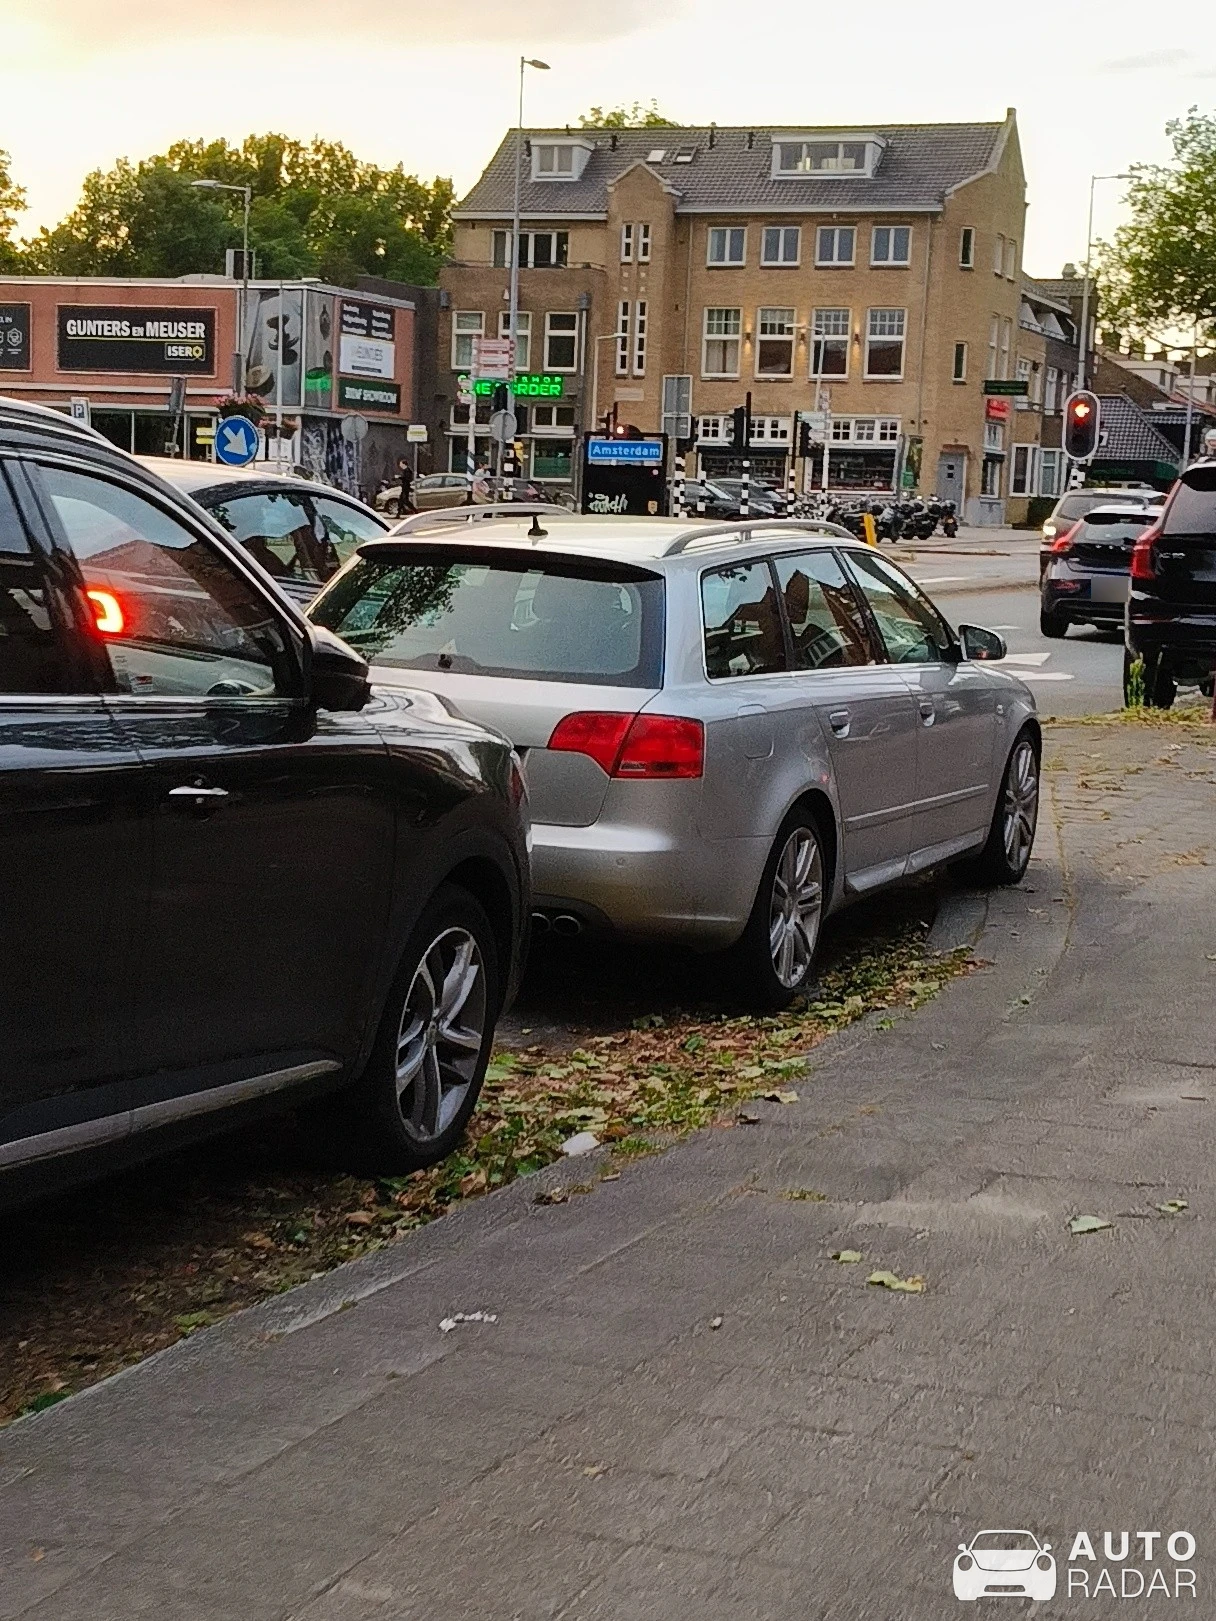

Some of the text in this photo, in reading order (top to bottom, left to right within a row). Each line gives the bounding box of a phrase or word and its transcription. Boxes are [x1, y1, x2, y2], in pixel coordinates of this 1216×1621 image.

[66, 319, 130, 337] GUNTERS
[146, 321, 206, 339] MEUSER
[167, 345, 203, 359] ISERO
[75, 404, 83, 417] P
[592, 445, 660, 457] Amsterdam
